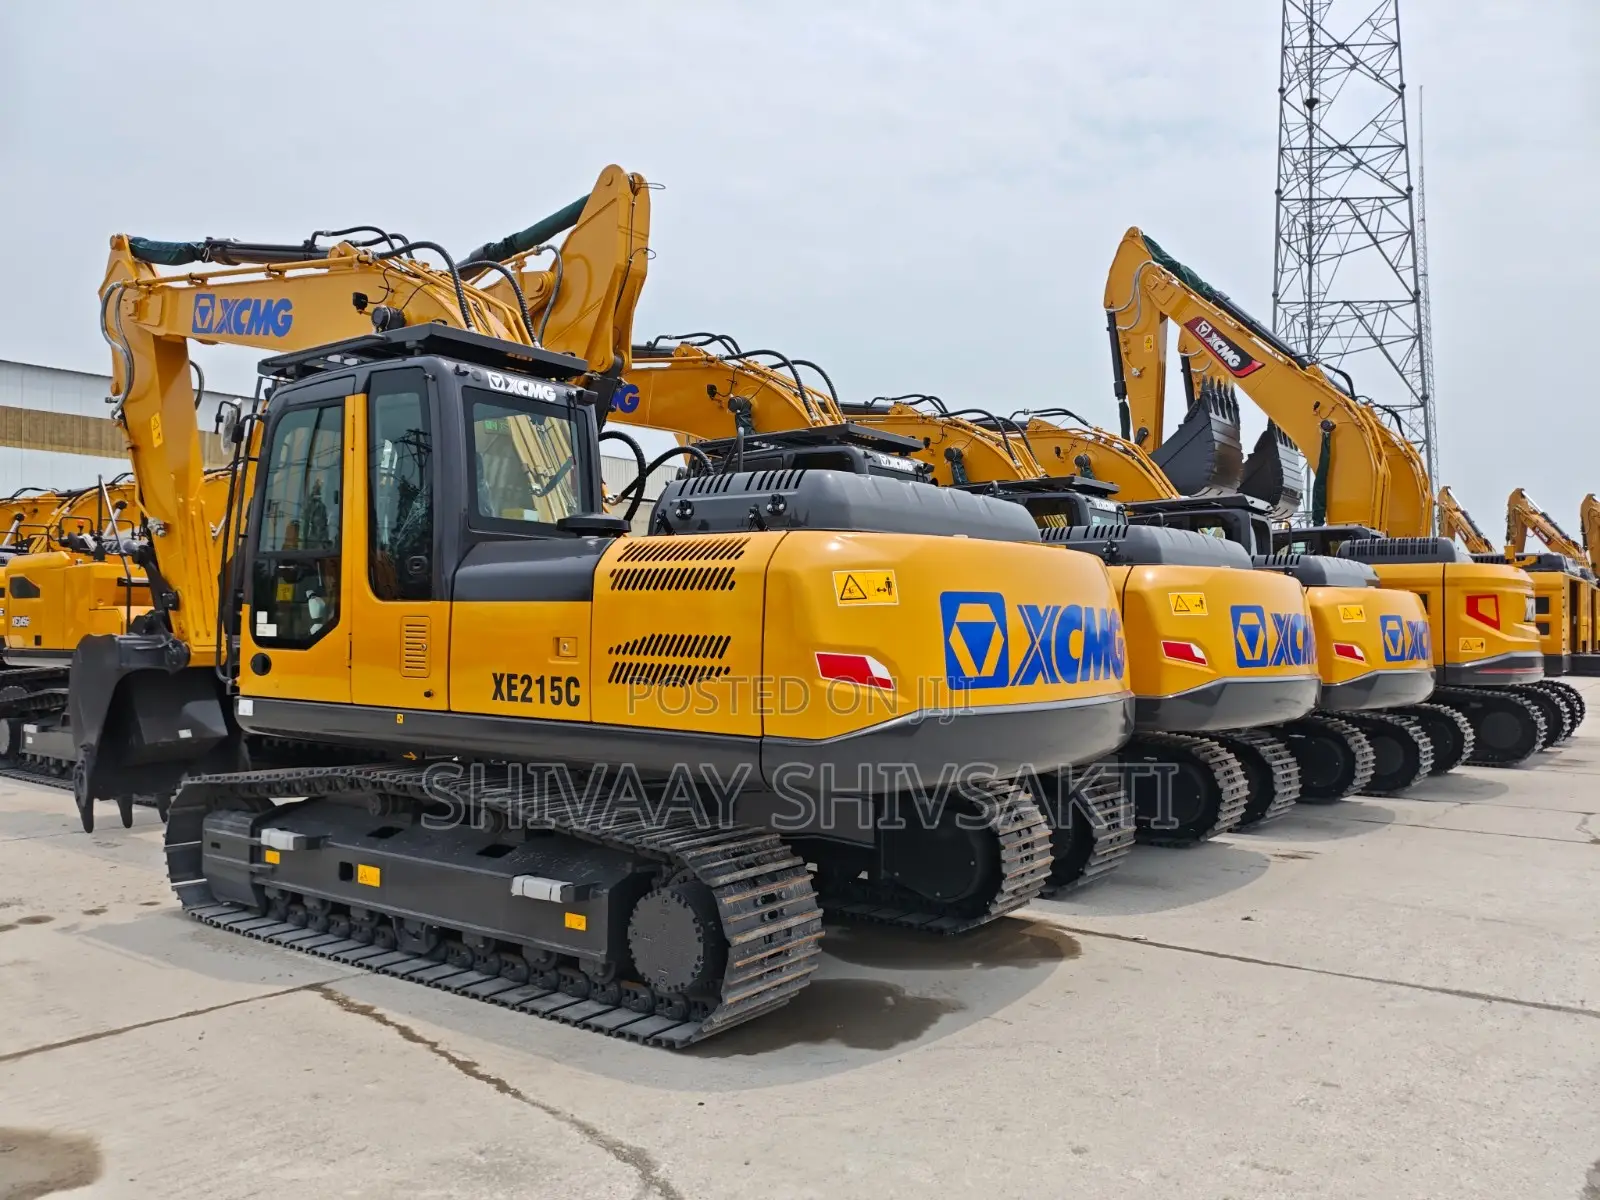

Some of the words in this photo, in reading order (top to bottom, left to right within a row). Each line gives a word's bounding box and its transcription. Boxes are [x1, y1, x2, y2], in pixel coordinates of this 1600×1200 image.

[214, 297, 293, 337] XCMG
[1203, 331, 1241, 367] XCMG
[505, 376, 557, 402] XCMG
[1010, 604, 1125, 686] XCMG
[492, 672, 581, 707] XE215C
